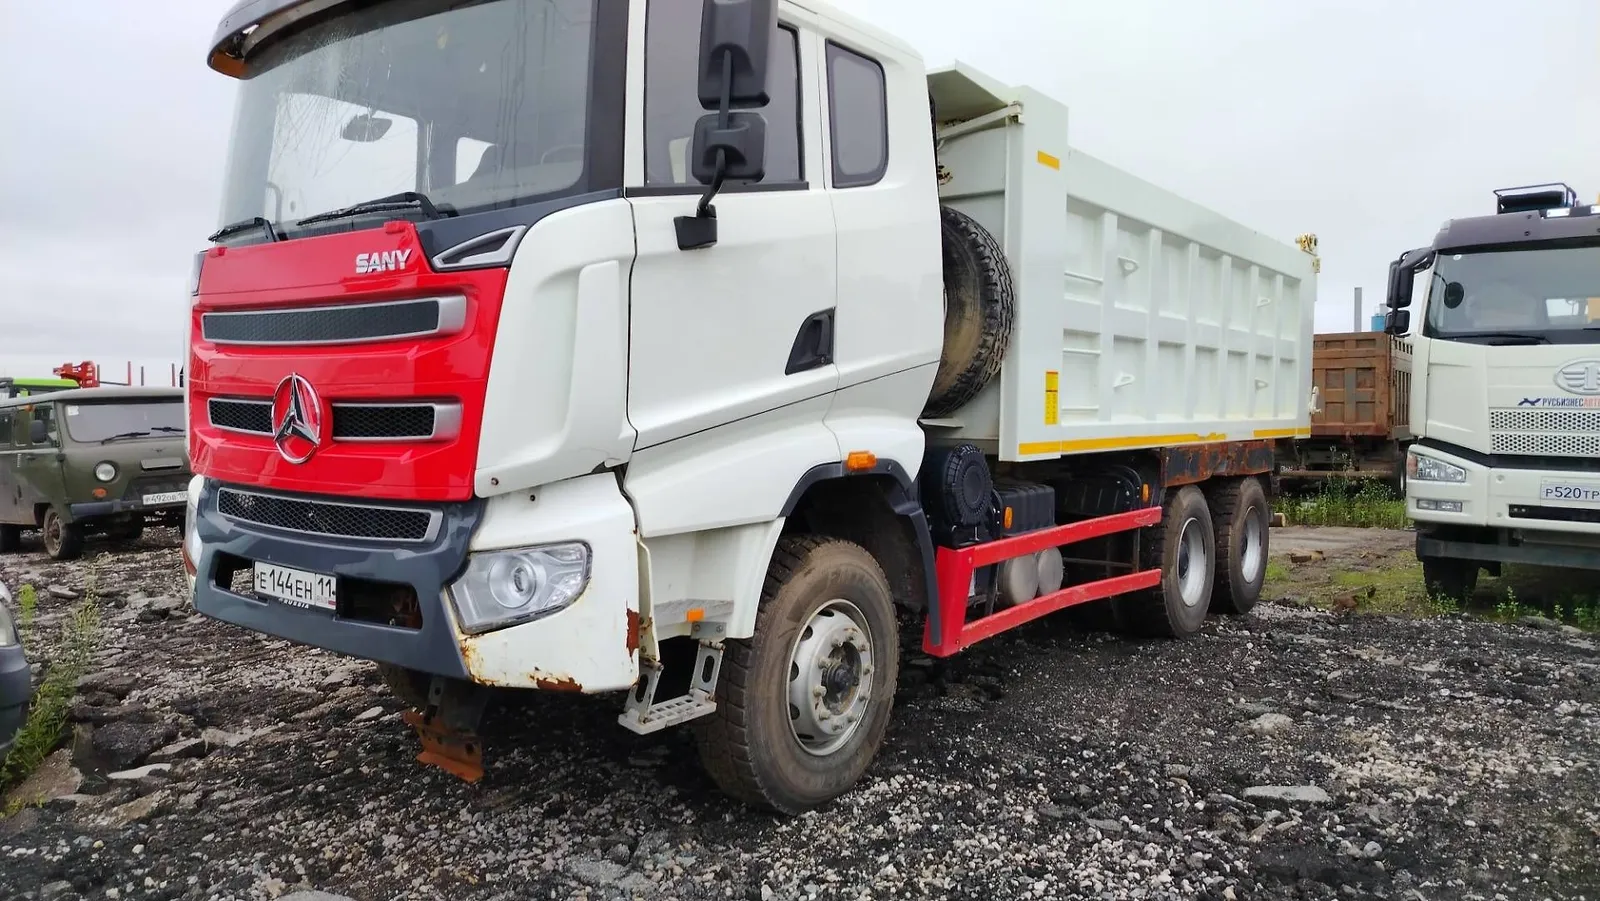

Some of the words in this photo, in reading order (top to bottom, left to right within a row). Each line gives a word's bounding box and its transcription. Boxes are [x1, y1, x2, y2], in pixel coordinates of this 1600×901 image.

[355, 248, 412, 274] SANY
[259, 568, 313, 601] Е144ЕН
[317, 577, 332, 598] 11
